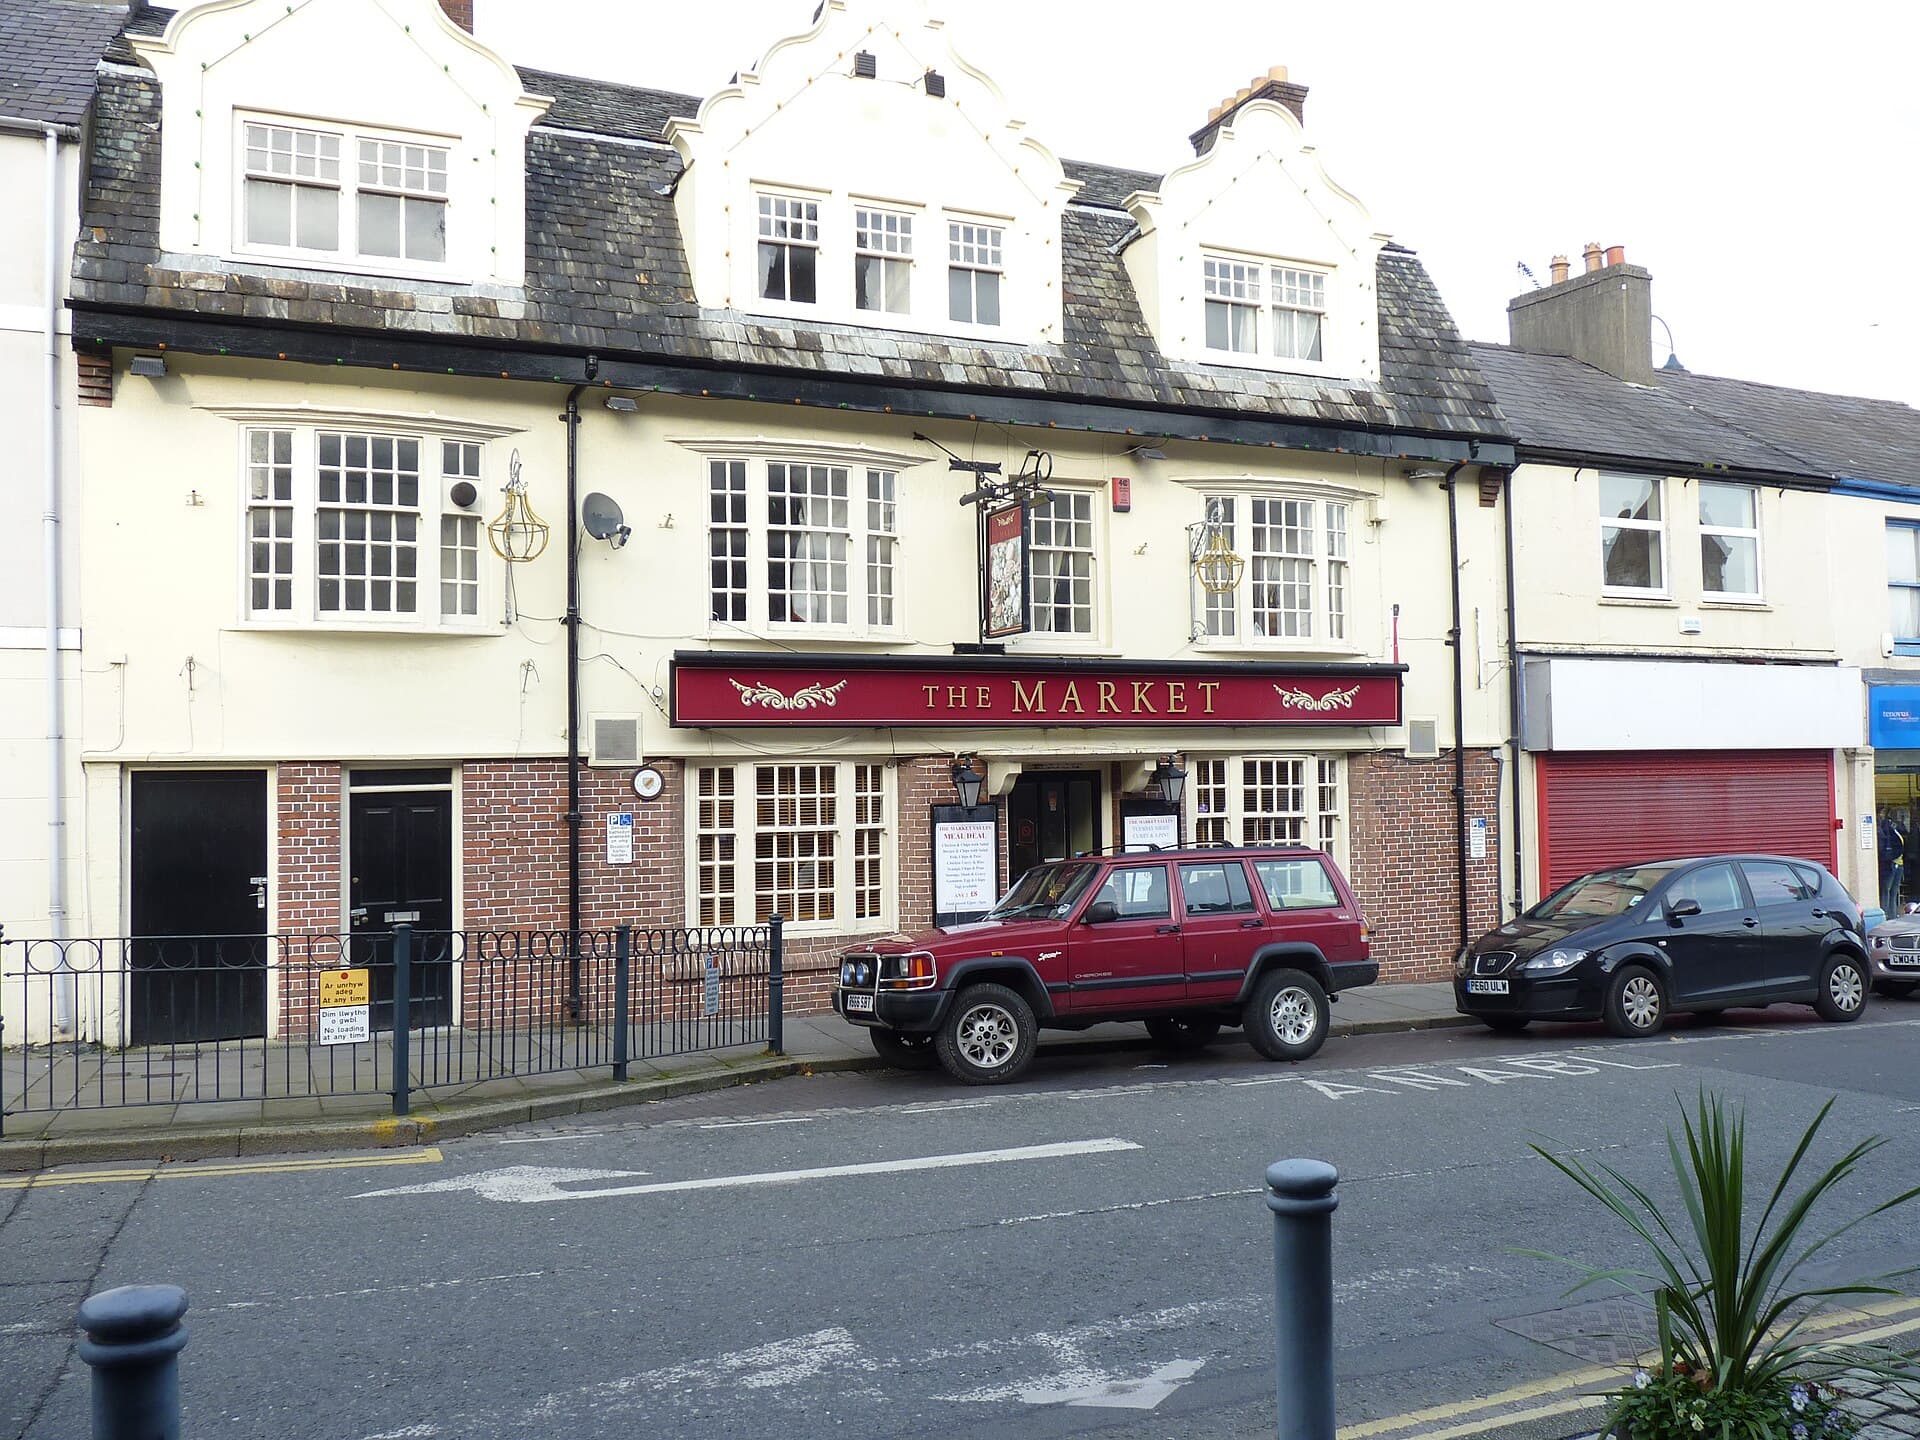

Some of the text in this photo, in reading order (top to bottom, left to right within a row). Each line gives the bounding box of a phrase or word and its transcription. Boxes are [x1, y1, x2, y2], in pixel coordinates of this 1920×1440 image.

[922, 680, 1220, 713] THE MARKET
[611, 816, 618, 824] P
[1038, 950, 1062, 961] Sport
[1471, 981, 1506, 992] PE60 ULW
